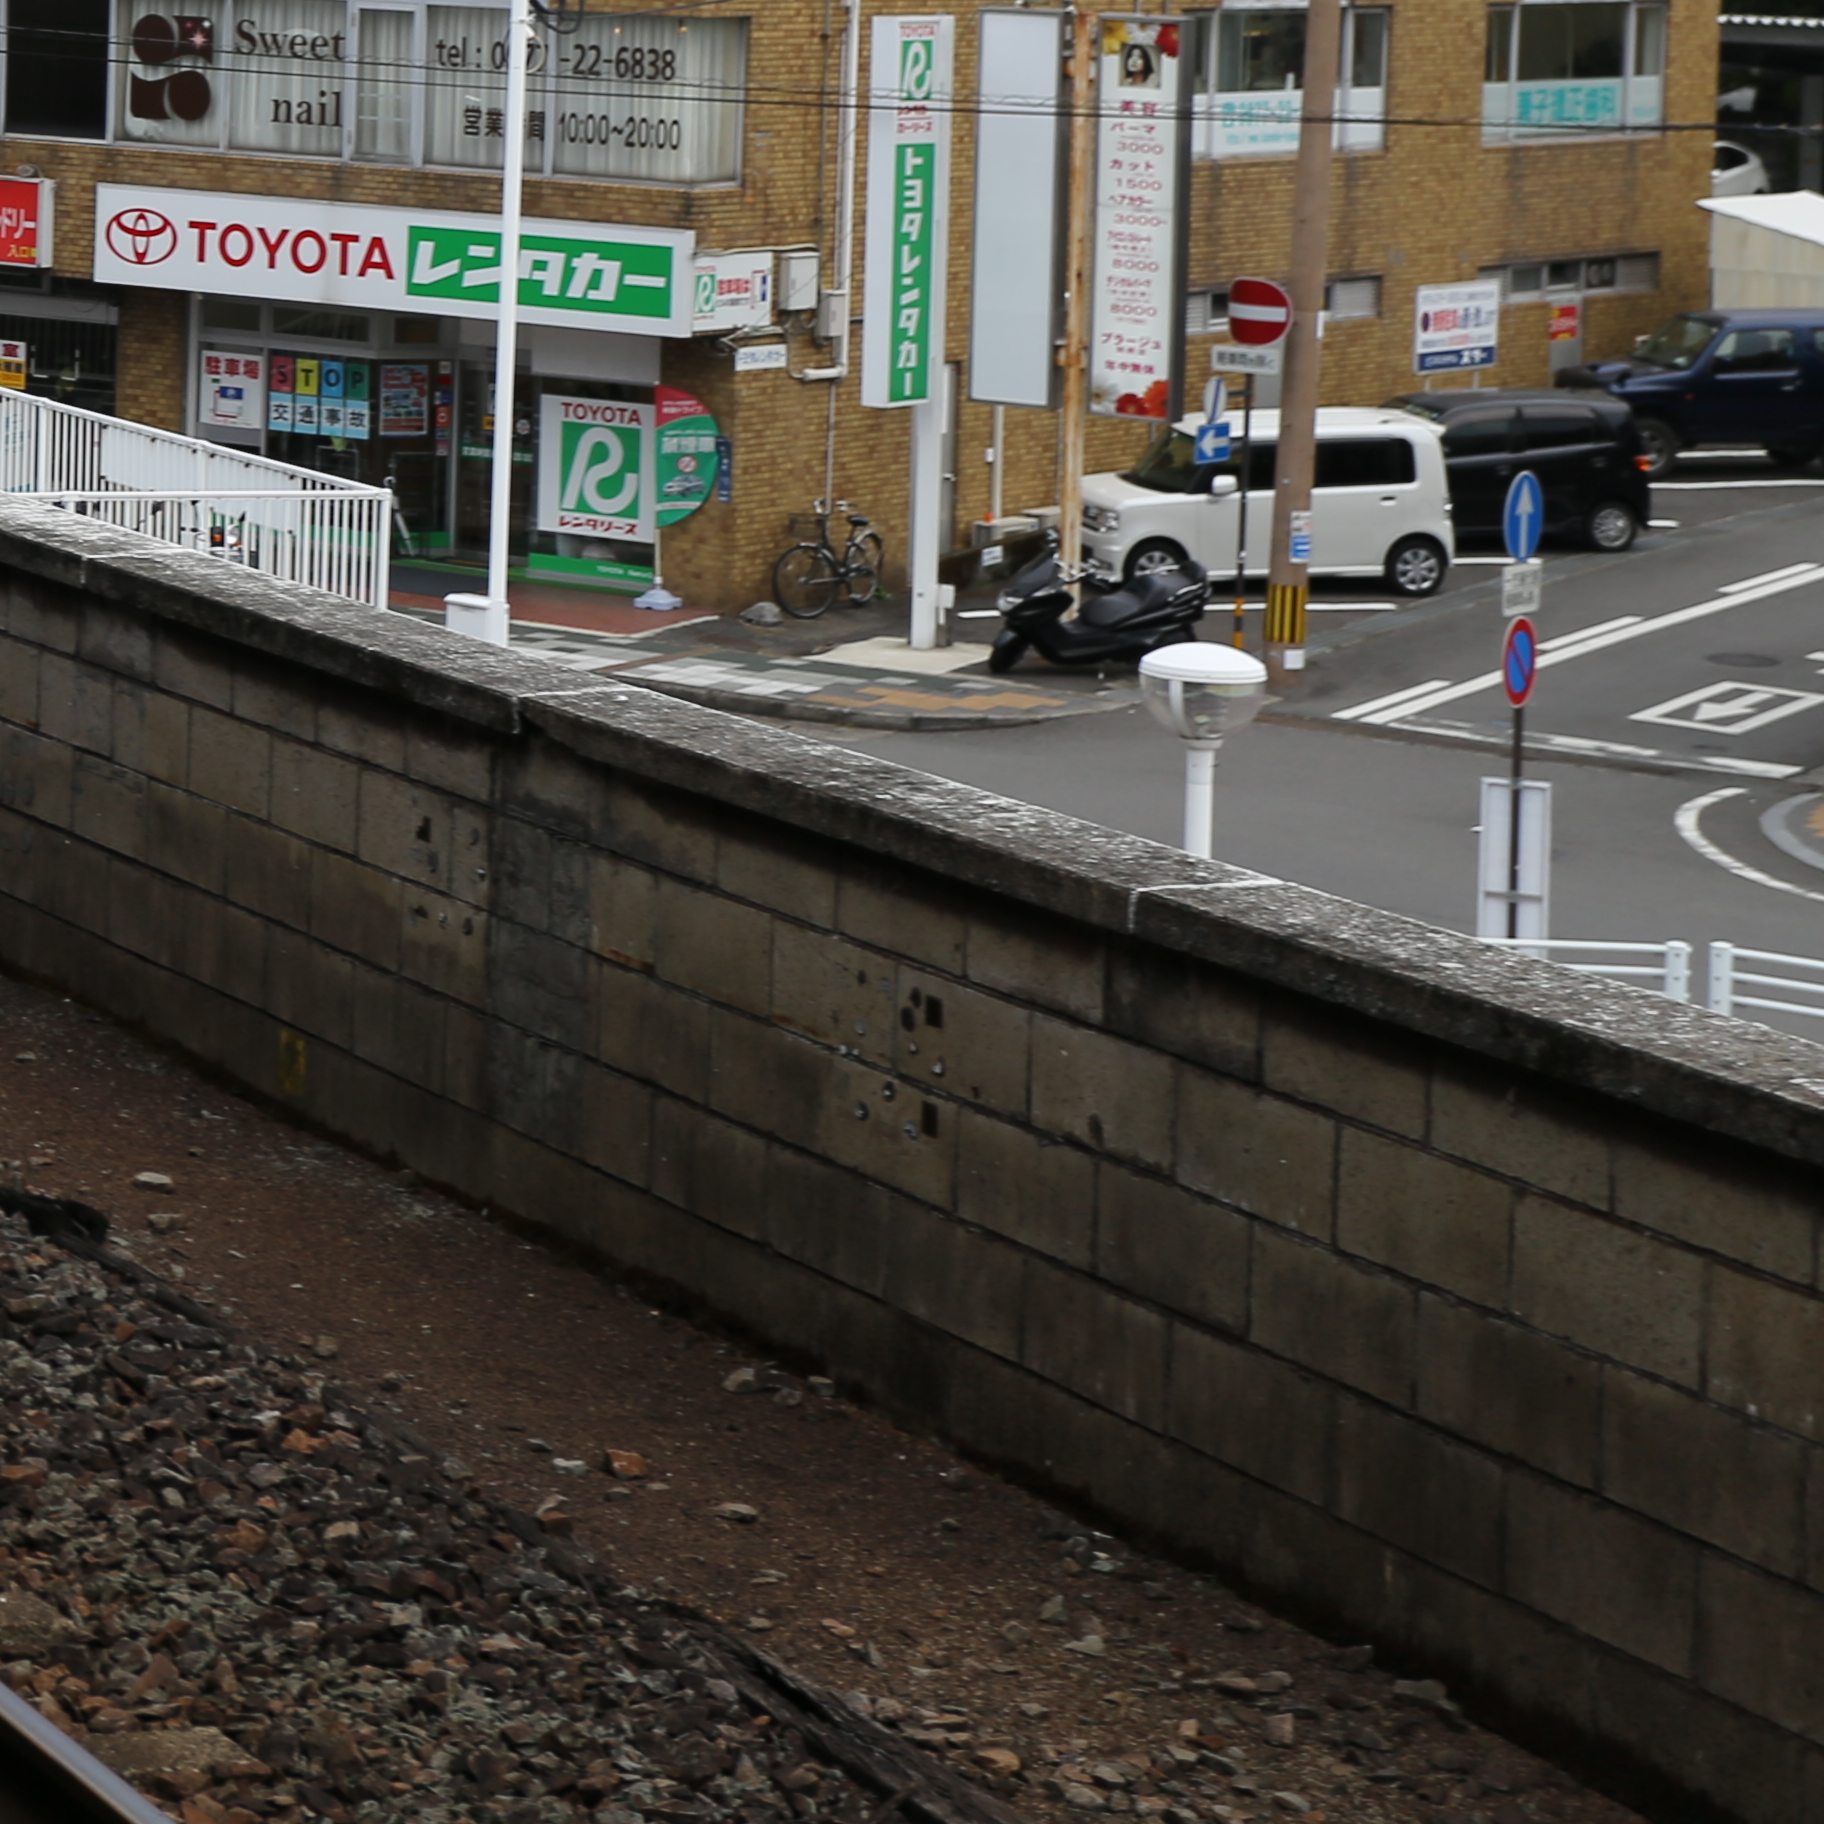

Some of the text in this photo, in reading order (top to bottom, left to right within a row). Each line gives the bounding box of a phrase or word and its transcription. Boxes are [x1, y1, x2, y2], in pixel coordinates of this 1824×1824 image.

[234, 18, 348, 61] Sweet
[271, 90, 343, 128] nail
[463, 105, 547, 142] 営業間
[1116, 141, 1164, 155] 3000
[1116, 178, 1163, 192] 1500
[188, 220, 395, 281] TOYOTA
[411, 240, 667, 302] レンタカー
[897, 147, 925, 397] トヨタレンタカー
[205, 355, 261, 380] 駐車場
[275, 363, 365, 388] STOP
[271, 401, 367, 429] 交通事故
[560, 402, 642, 426] TOYOTA
